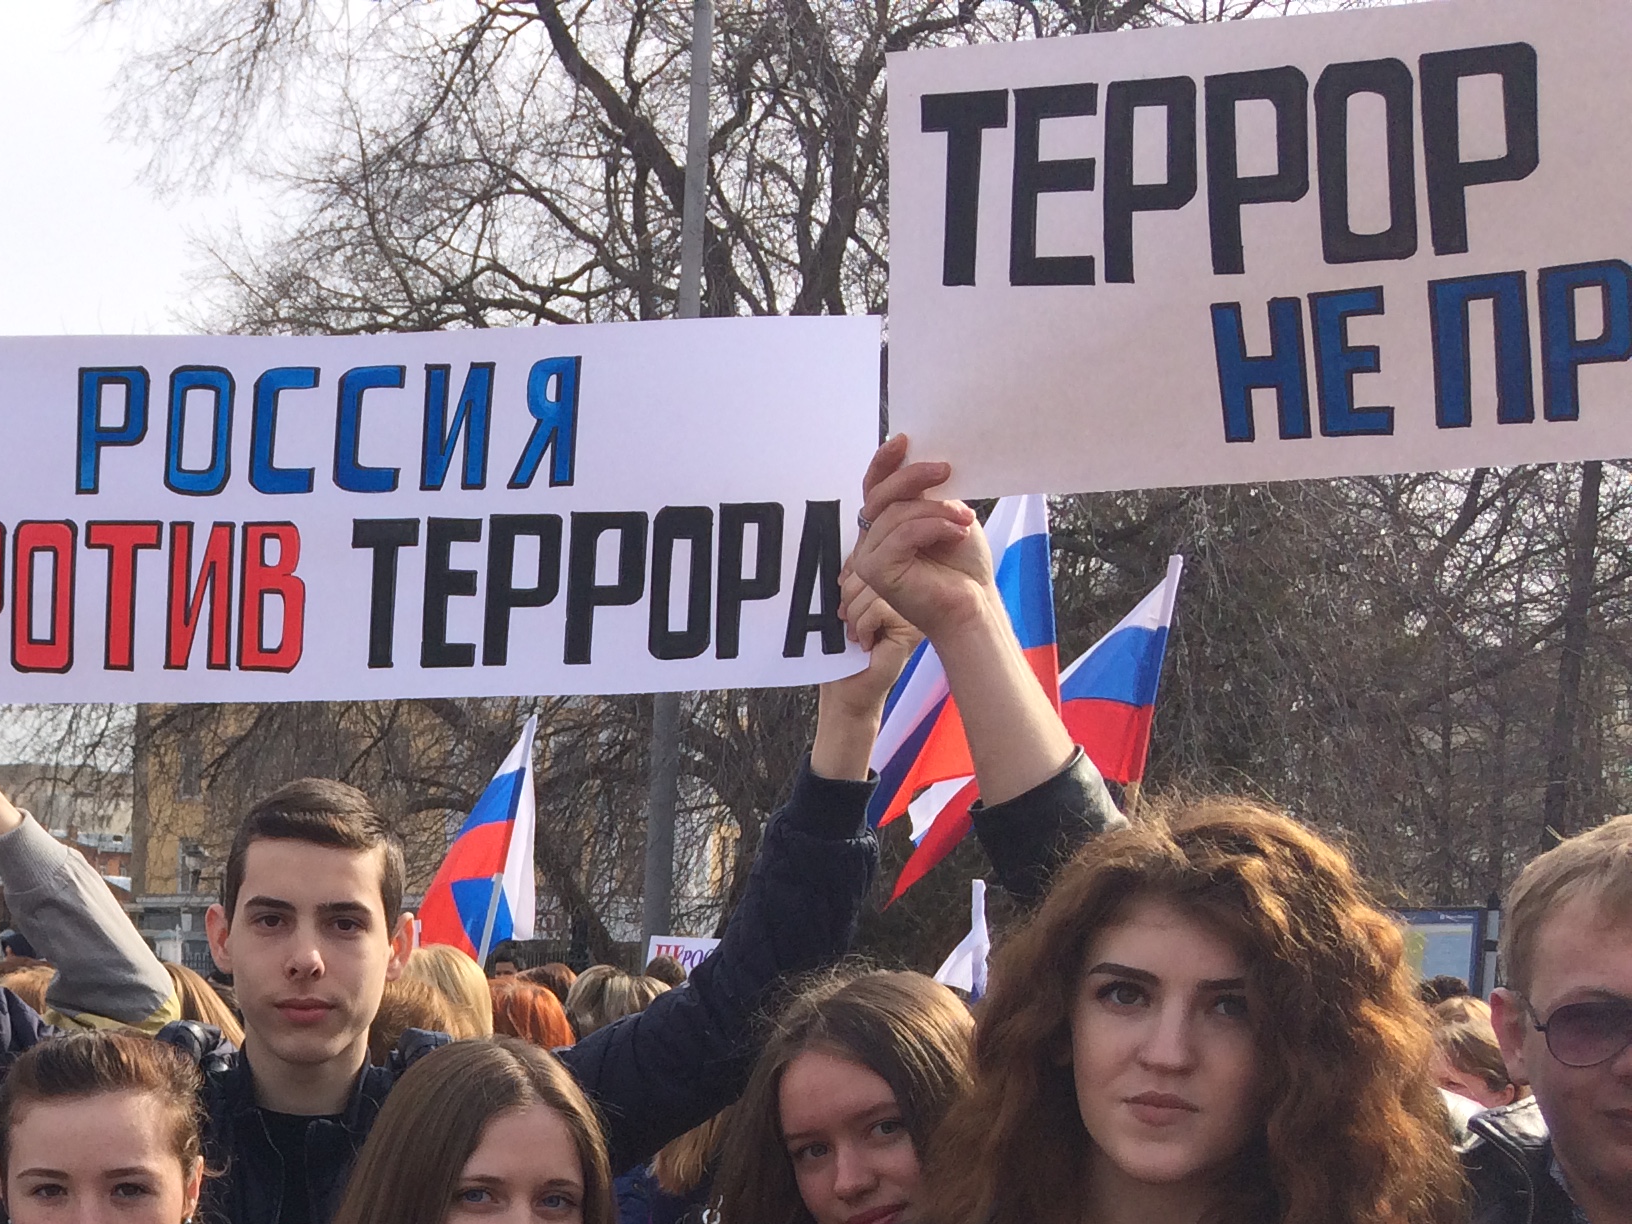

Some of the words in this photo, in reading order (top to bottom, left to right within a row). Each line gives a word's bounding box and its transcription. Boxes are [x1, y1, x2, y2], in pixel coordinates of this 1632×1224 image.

[920, 42, 1540, 287] ТЕРРОР
[74, 354, 582, 496] РОССИЯ
[1210, 285, 1395, 444] НЕ
[351, 498, 846, 670] ТЕРРОРА
